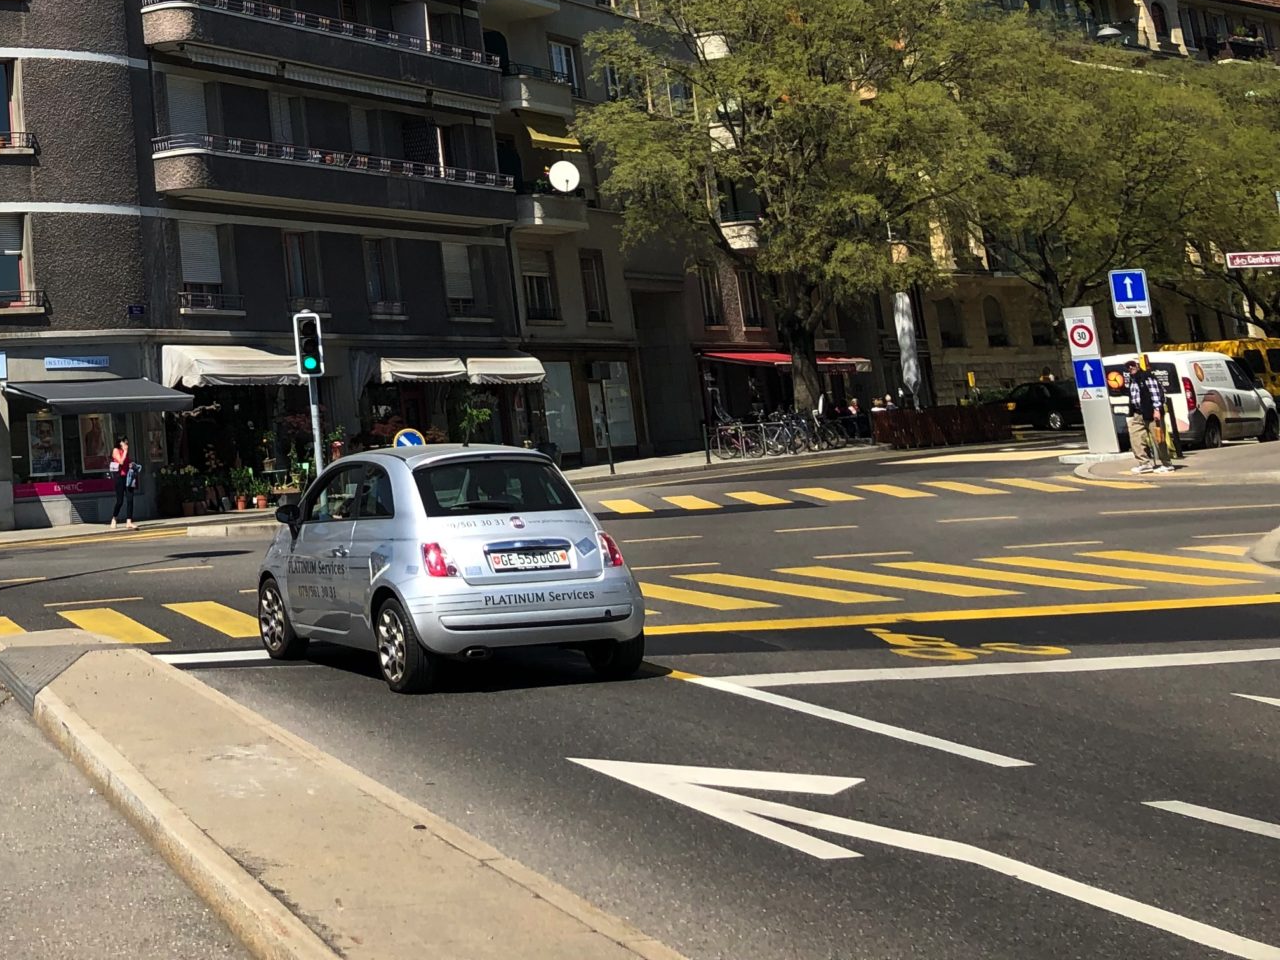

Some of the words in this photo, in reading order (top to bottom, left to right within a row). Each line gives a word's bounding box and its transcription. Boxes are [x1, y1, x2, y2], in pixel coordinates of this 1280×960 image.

[1076, 331, 1087, 341] 30
[481, 519, 493, 527] 30
[500, 553, 516, 567] GE
[288, 560, 317, 575] PLATINUM
[318, 560, 346, 576] Services
[484, 594, 546, 606] PLATINUM
[549, 590, 595, 602] Services
